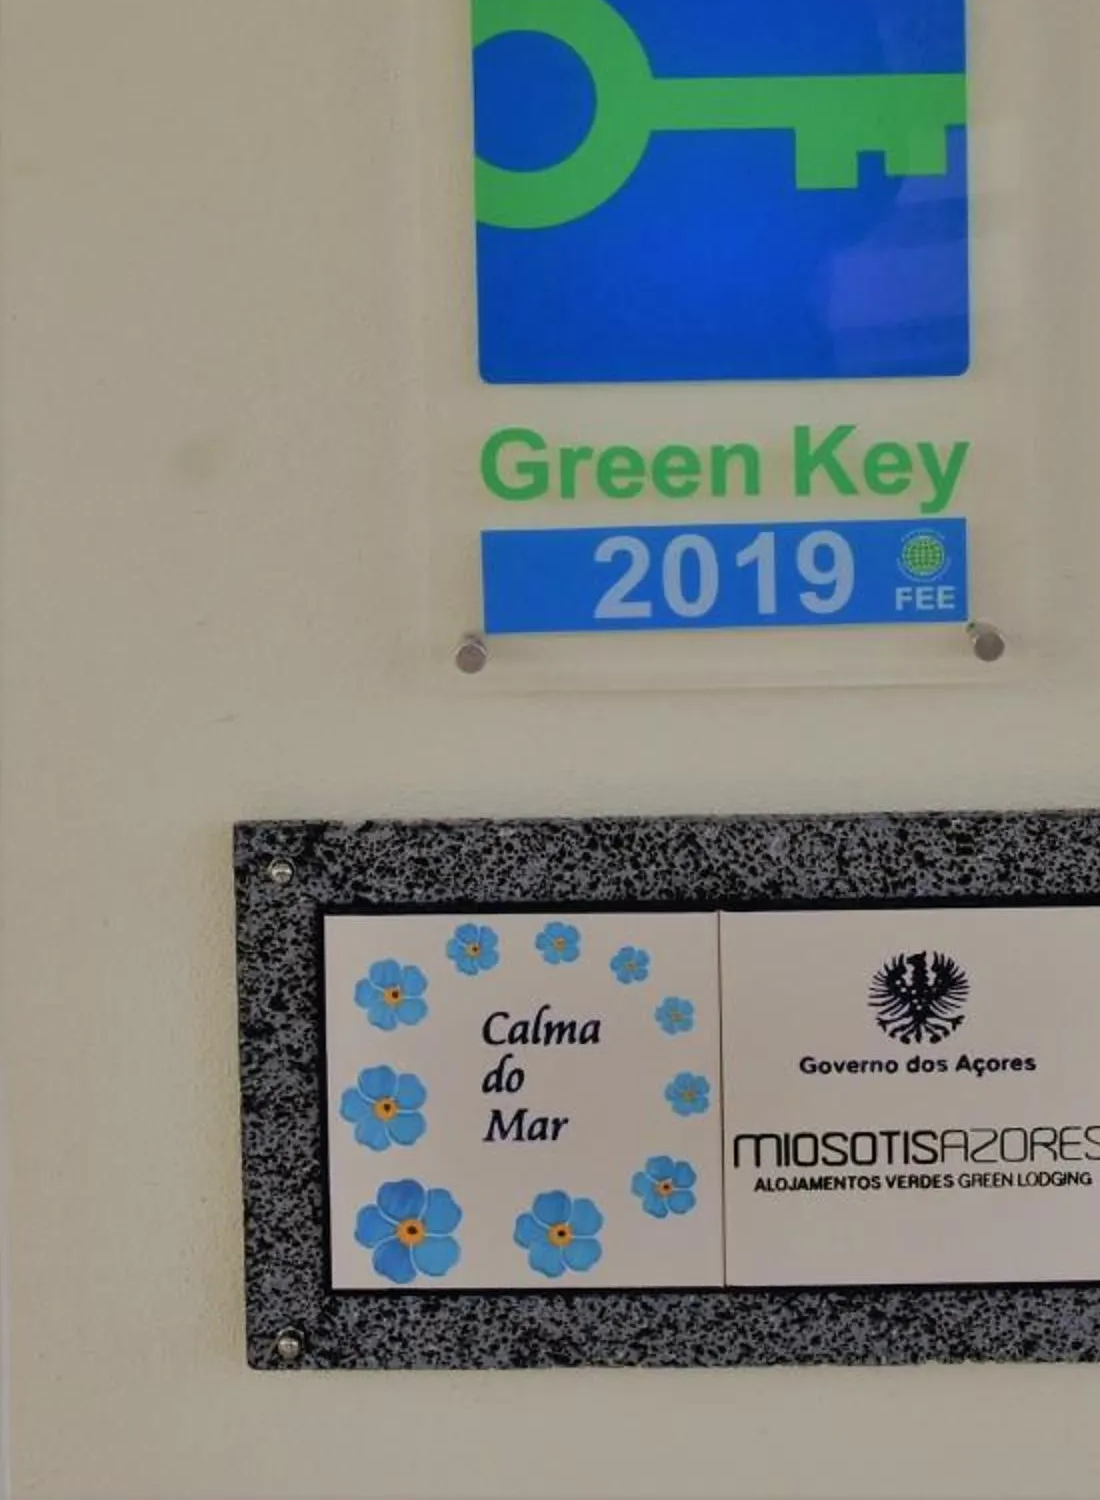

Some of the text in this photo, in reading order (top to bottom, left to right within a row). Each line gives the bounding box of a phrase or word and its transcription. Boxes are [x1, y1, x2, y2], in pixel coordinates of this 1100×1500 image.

[480, 424, 971, 514] Green Key
[592, 529, 856, 620] 2019
[895, 585, 956, 611] FEE
[482, 1003, 602, 1046] Calma
[482, 1053, 526, 1094] do
[799, 1053, 1037, 1077] Governo dos Açores
[482, 1107, 570, 1143] Mar
[754, 1171, 1093, 1193] ALOJAMENTOS VERDES GREEN LODGING
